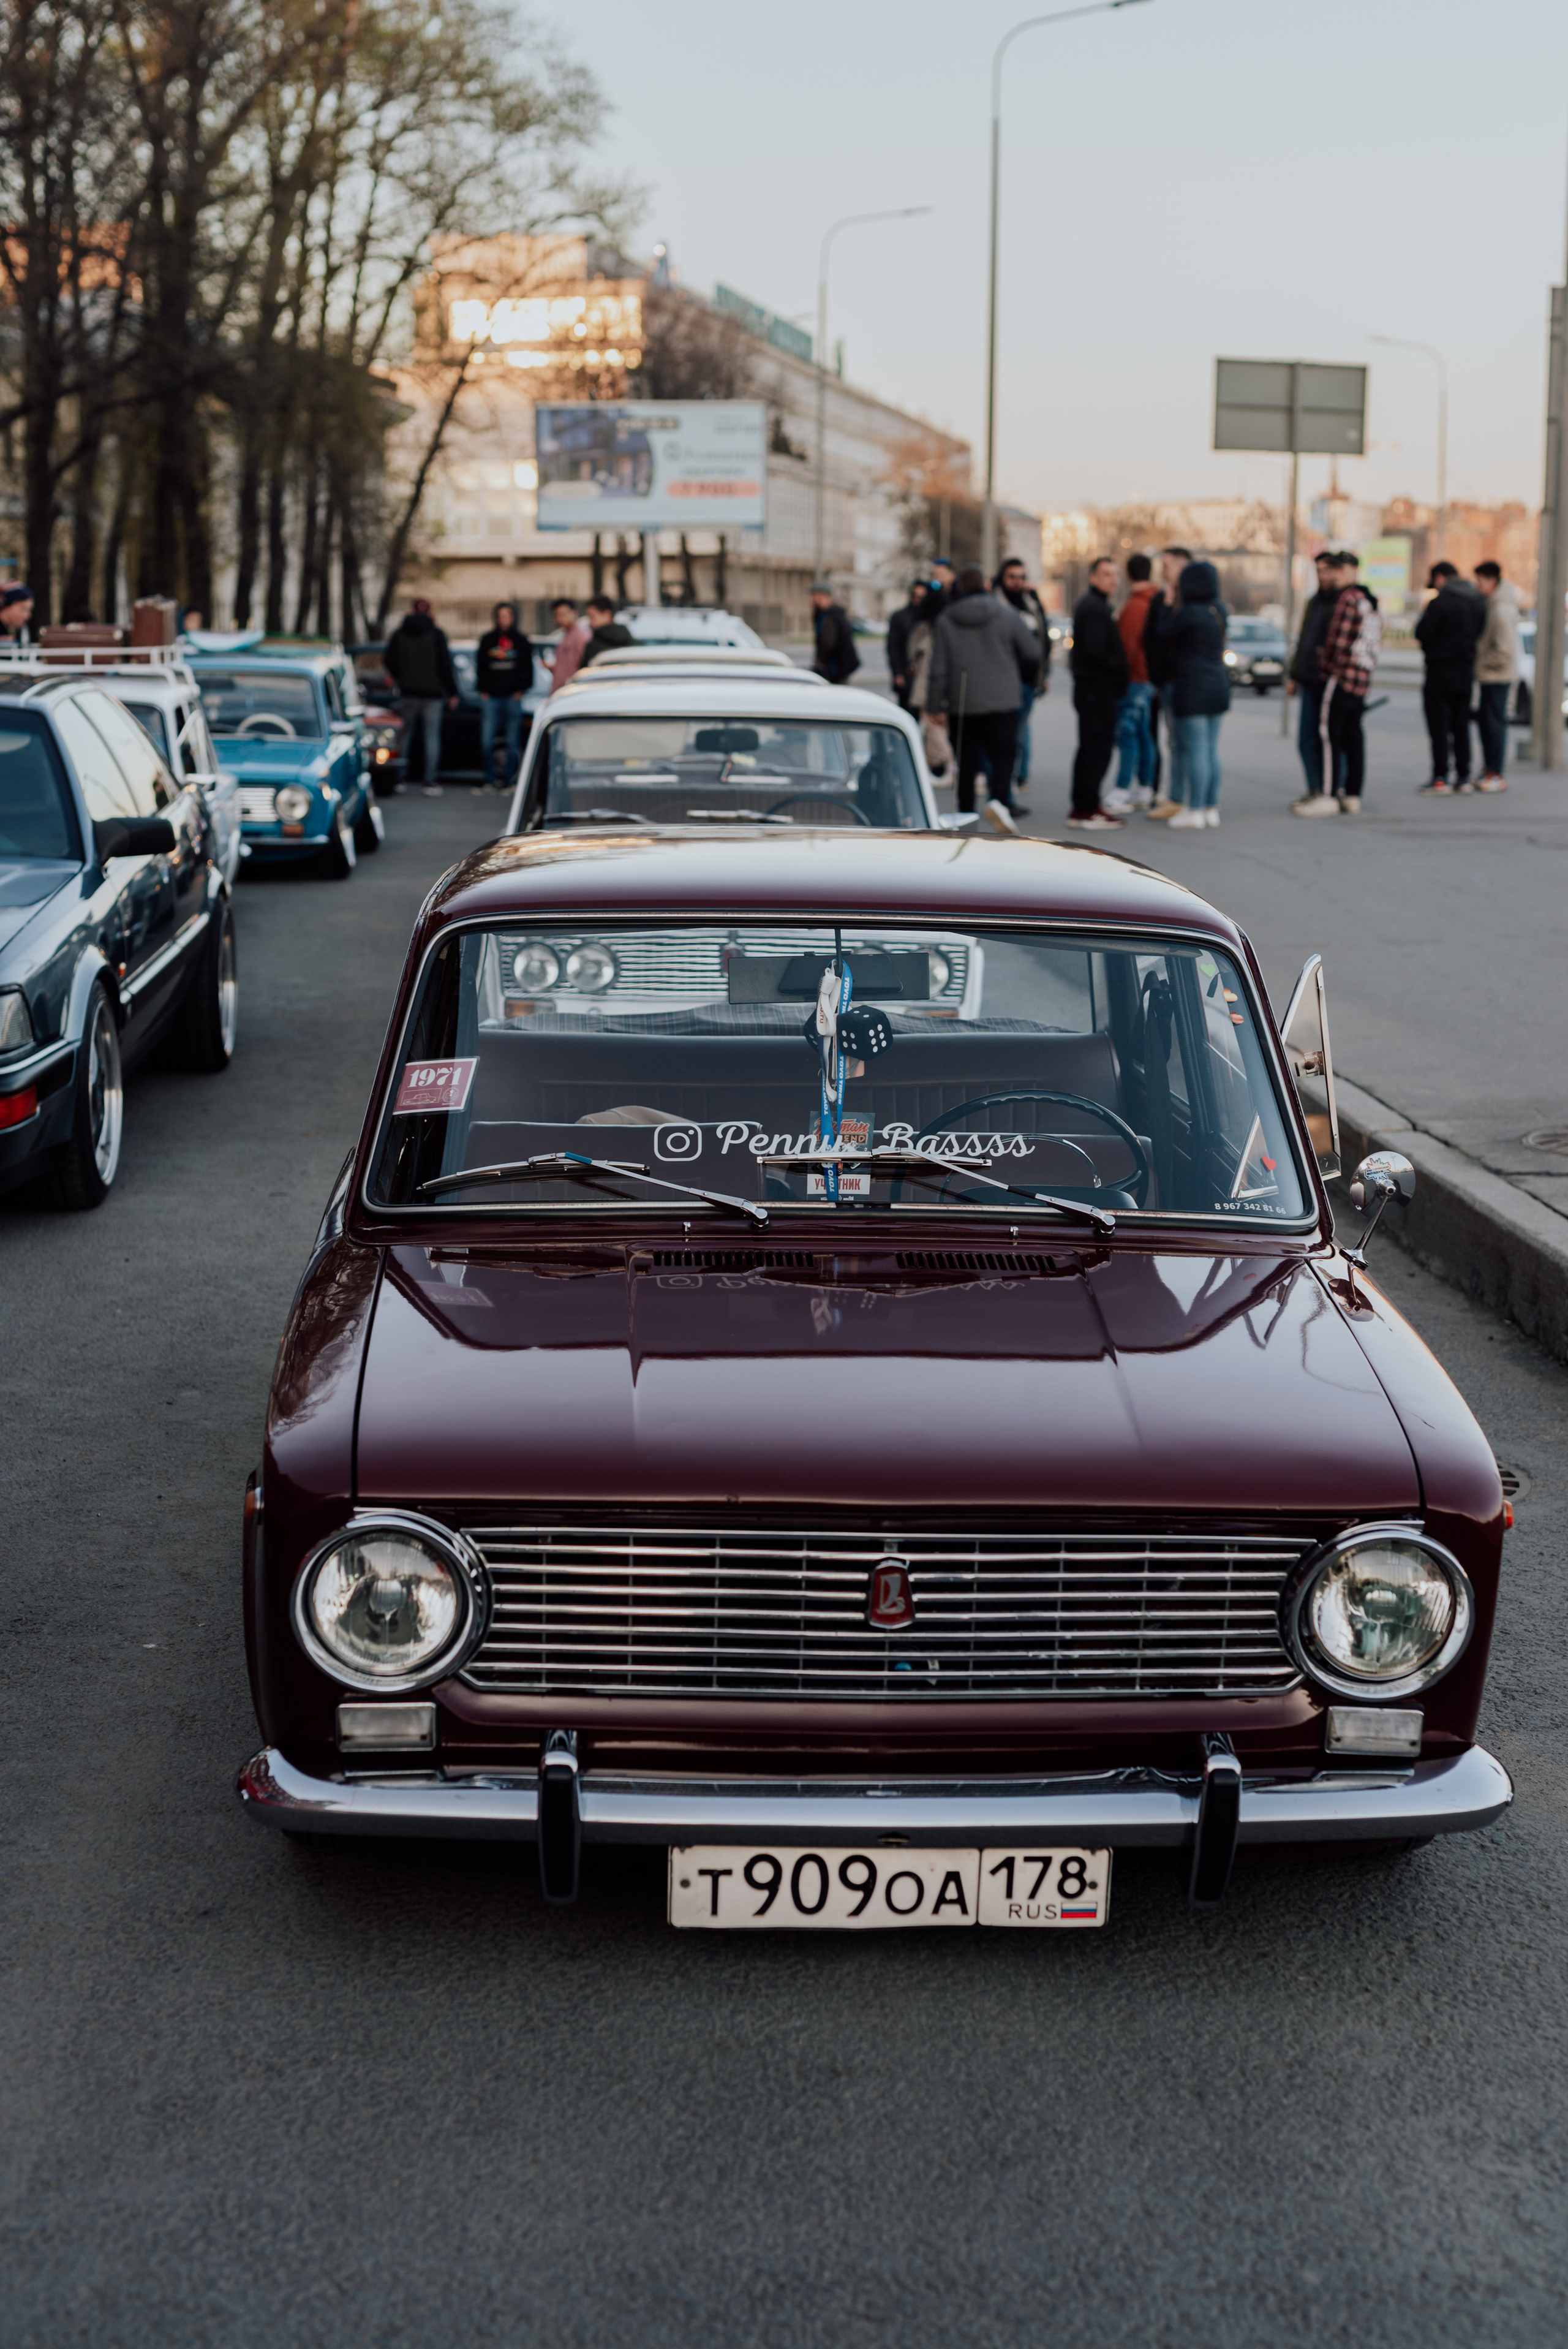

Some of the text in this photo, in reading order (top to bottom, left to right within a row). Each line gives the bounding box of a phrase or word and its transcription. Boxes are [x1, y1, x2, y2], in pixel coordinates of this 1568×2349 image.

[407, 1067, 462, 1088] 1971
[815, 1178, 861, 1190] УЧТНИК
[989, 1855, 1087, 1900] 178
[1009, 1903, 1057, 1920] RUS
